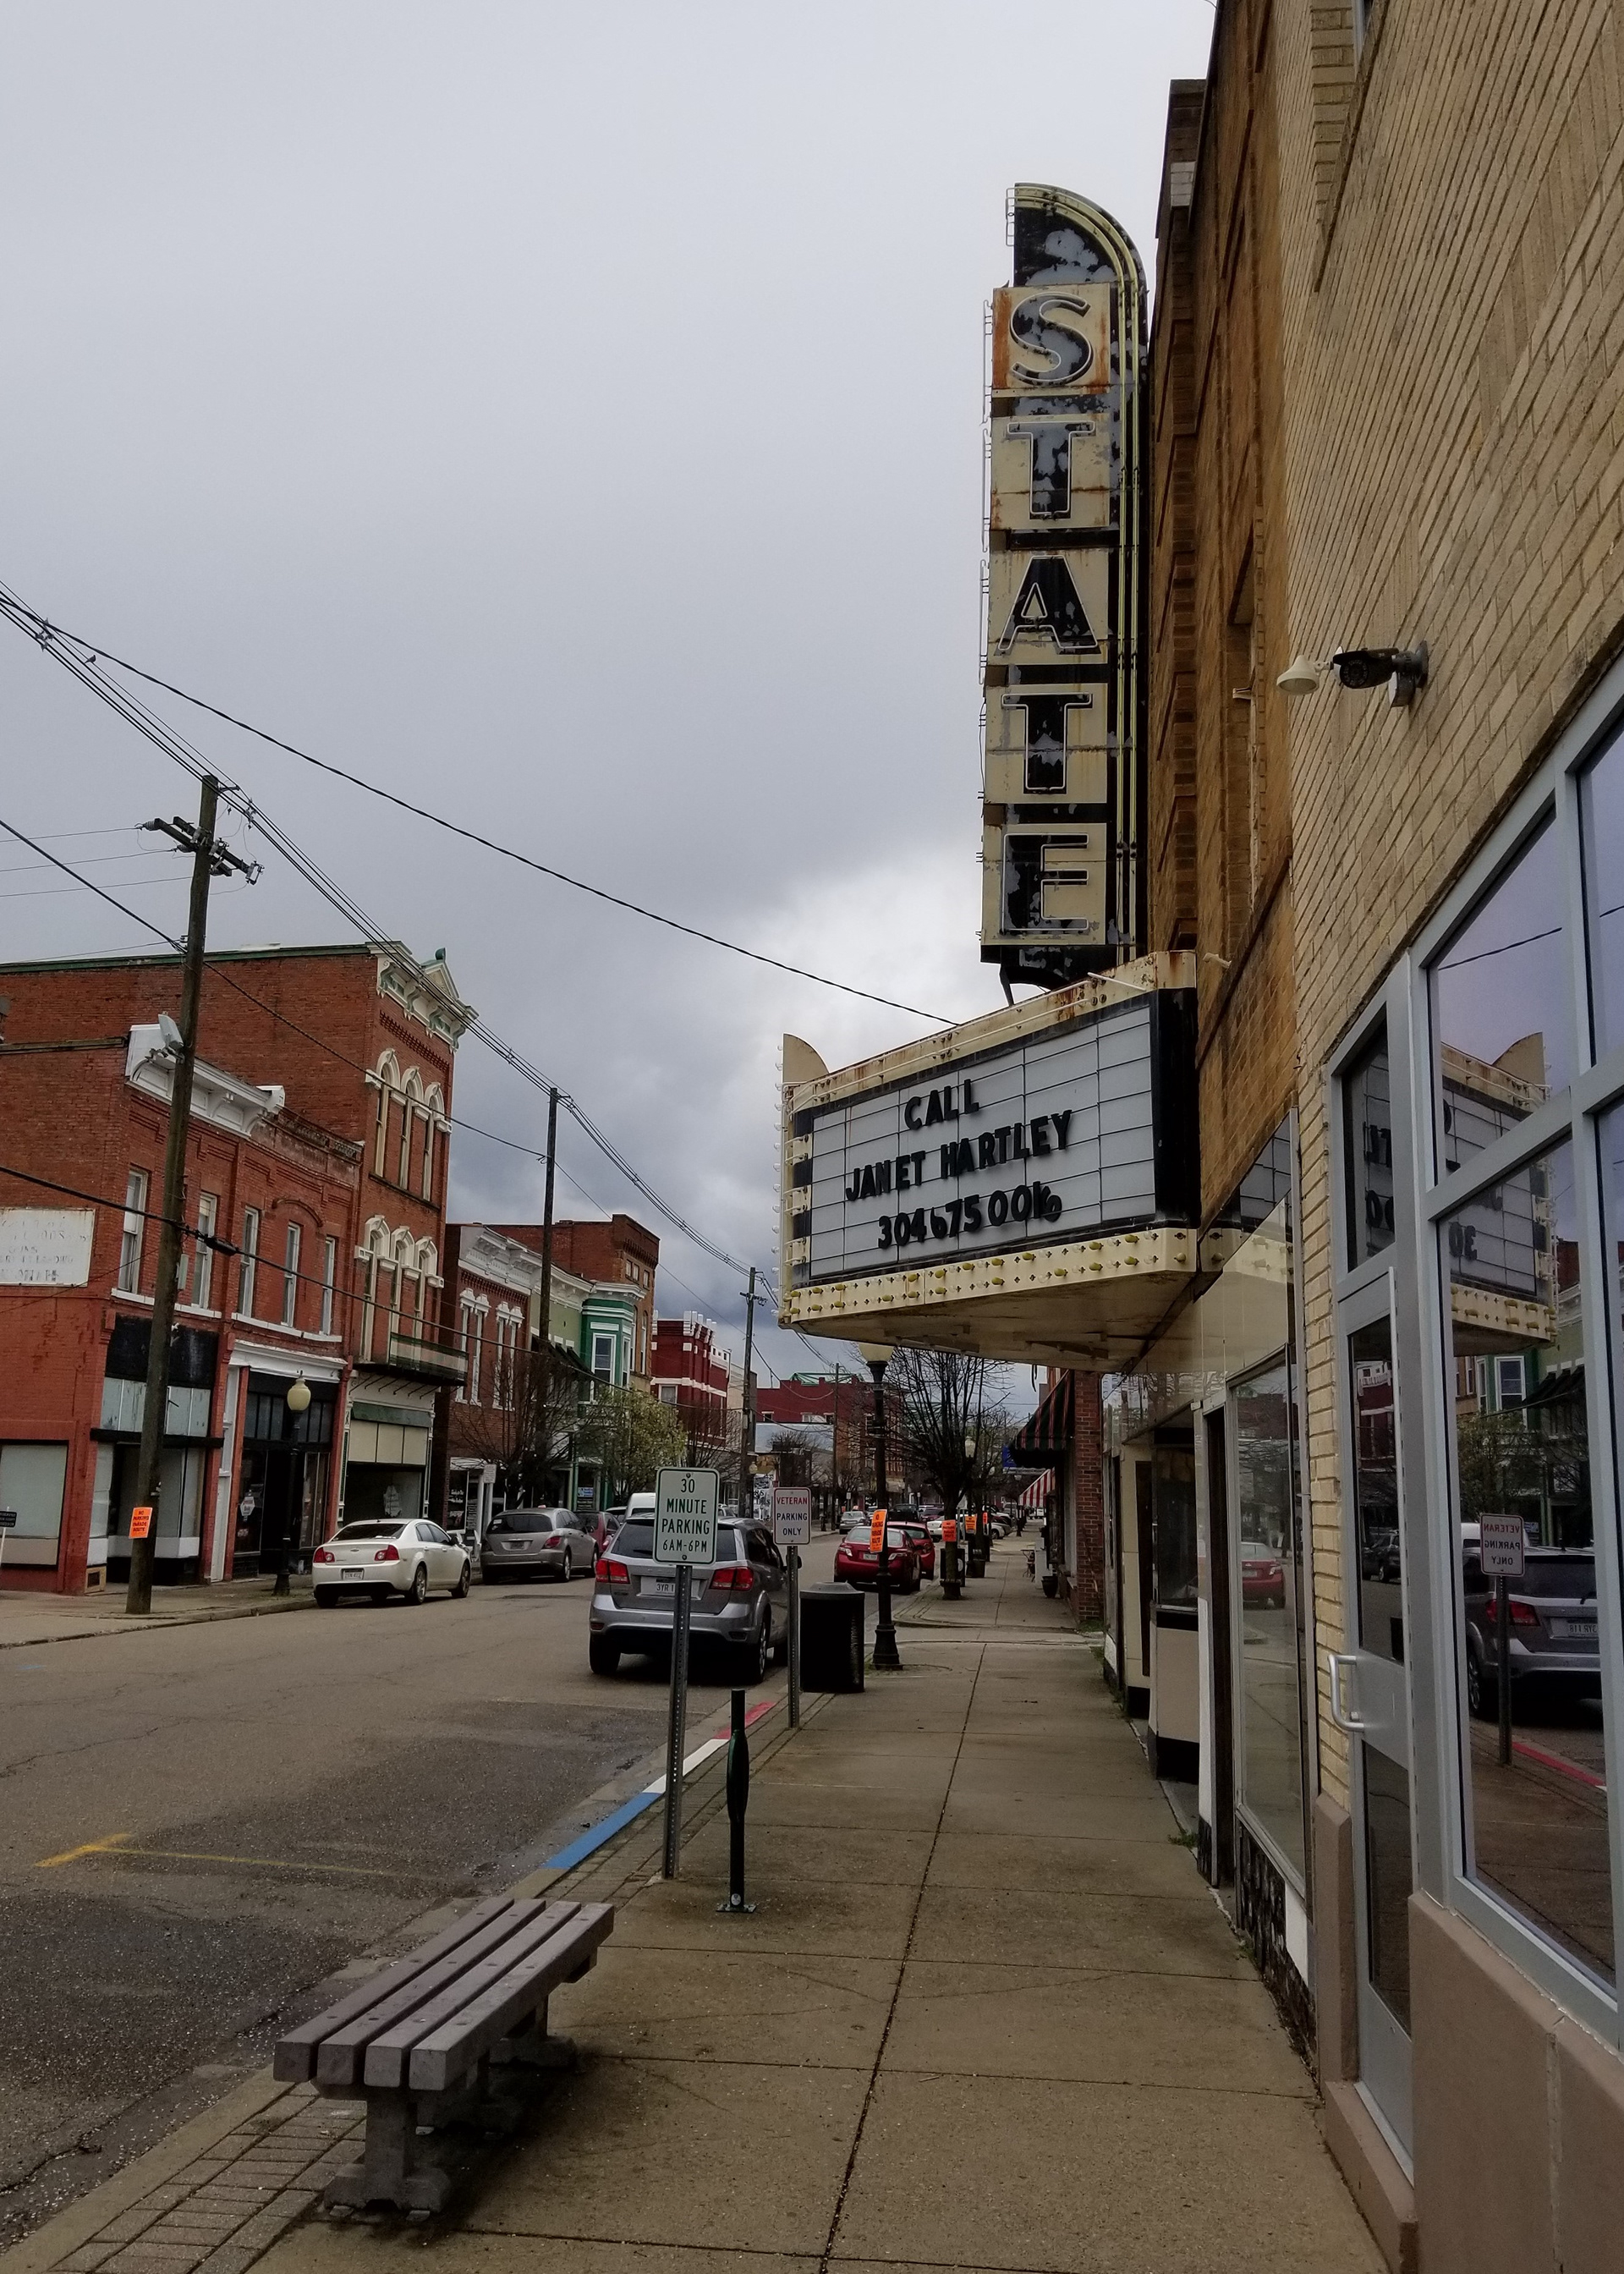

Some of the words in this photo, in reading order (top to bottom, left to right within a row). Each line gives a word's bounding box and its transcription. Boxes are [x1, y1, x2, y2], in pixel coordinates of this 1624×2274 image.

[996, 289, 1101, 933] STATE
[904, 1079, 979, 1130] CALL
[846, 1151, 925, 1201] JANET
[941, 1110, 1073, 1179] HARTLEY
[681, 1479, 695, 1493] 30
[667, 1498, 707, 1514] MINUTE
[776, 1497, 808, 1505] VETERAN
[776, 1513, 808, 1521] PARKING
[661, 1519, 710, 1535] PARKING
[662, 1540, 707, 1552] 6AM-6PM
